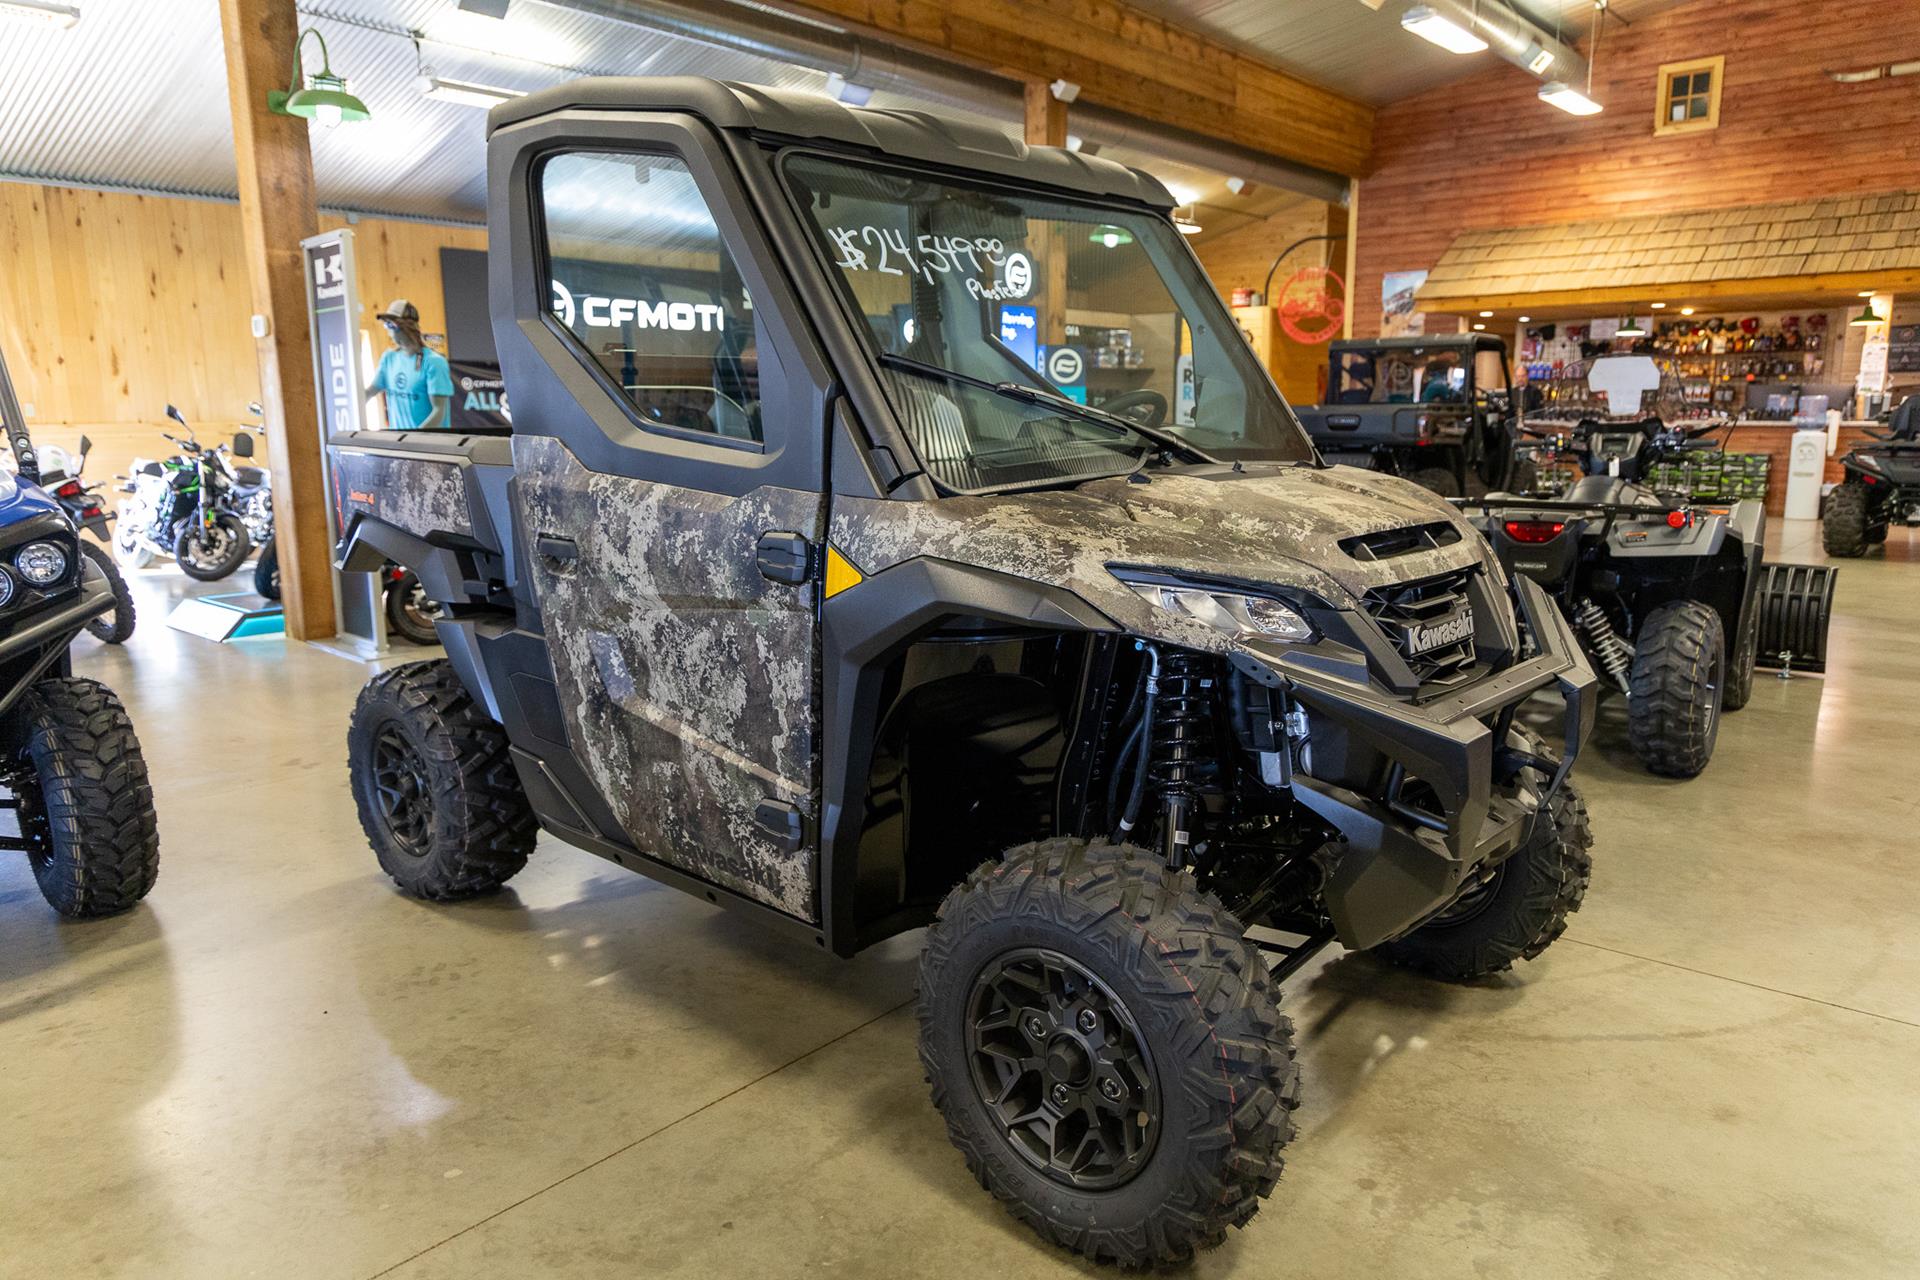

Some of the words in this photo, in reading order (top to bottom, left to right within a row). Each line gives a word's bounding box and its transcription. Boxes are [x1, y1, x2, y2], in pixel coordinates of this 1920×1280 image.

[329, 343, 350, 431] SIDE
[464, 391, 499, 411] ALL
[1408, 609, 1474, 654] Kawasaki
